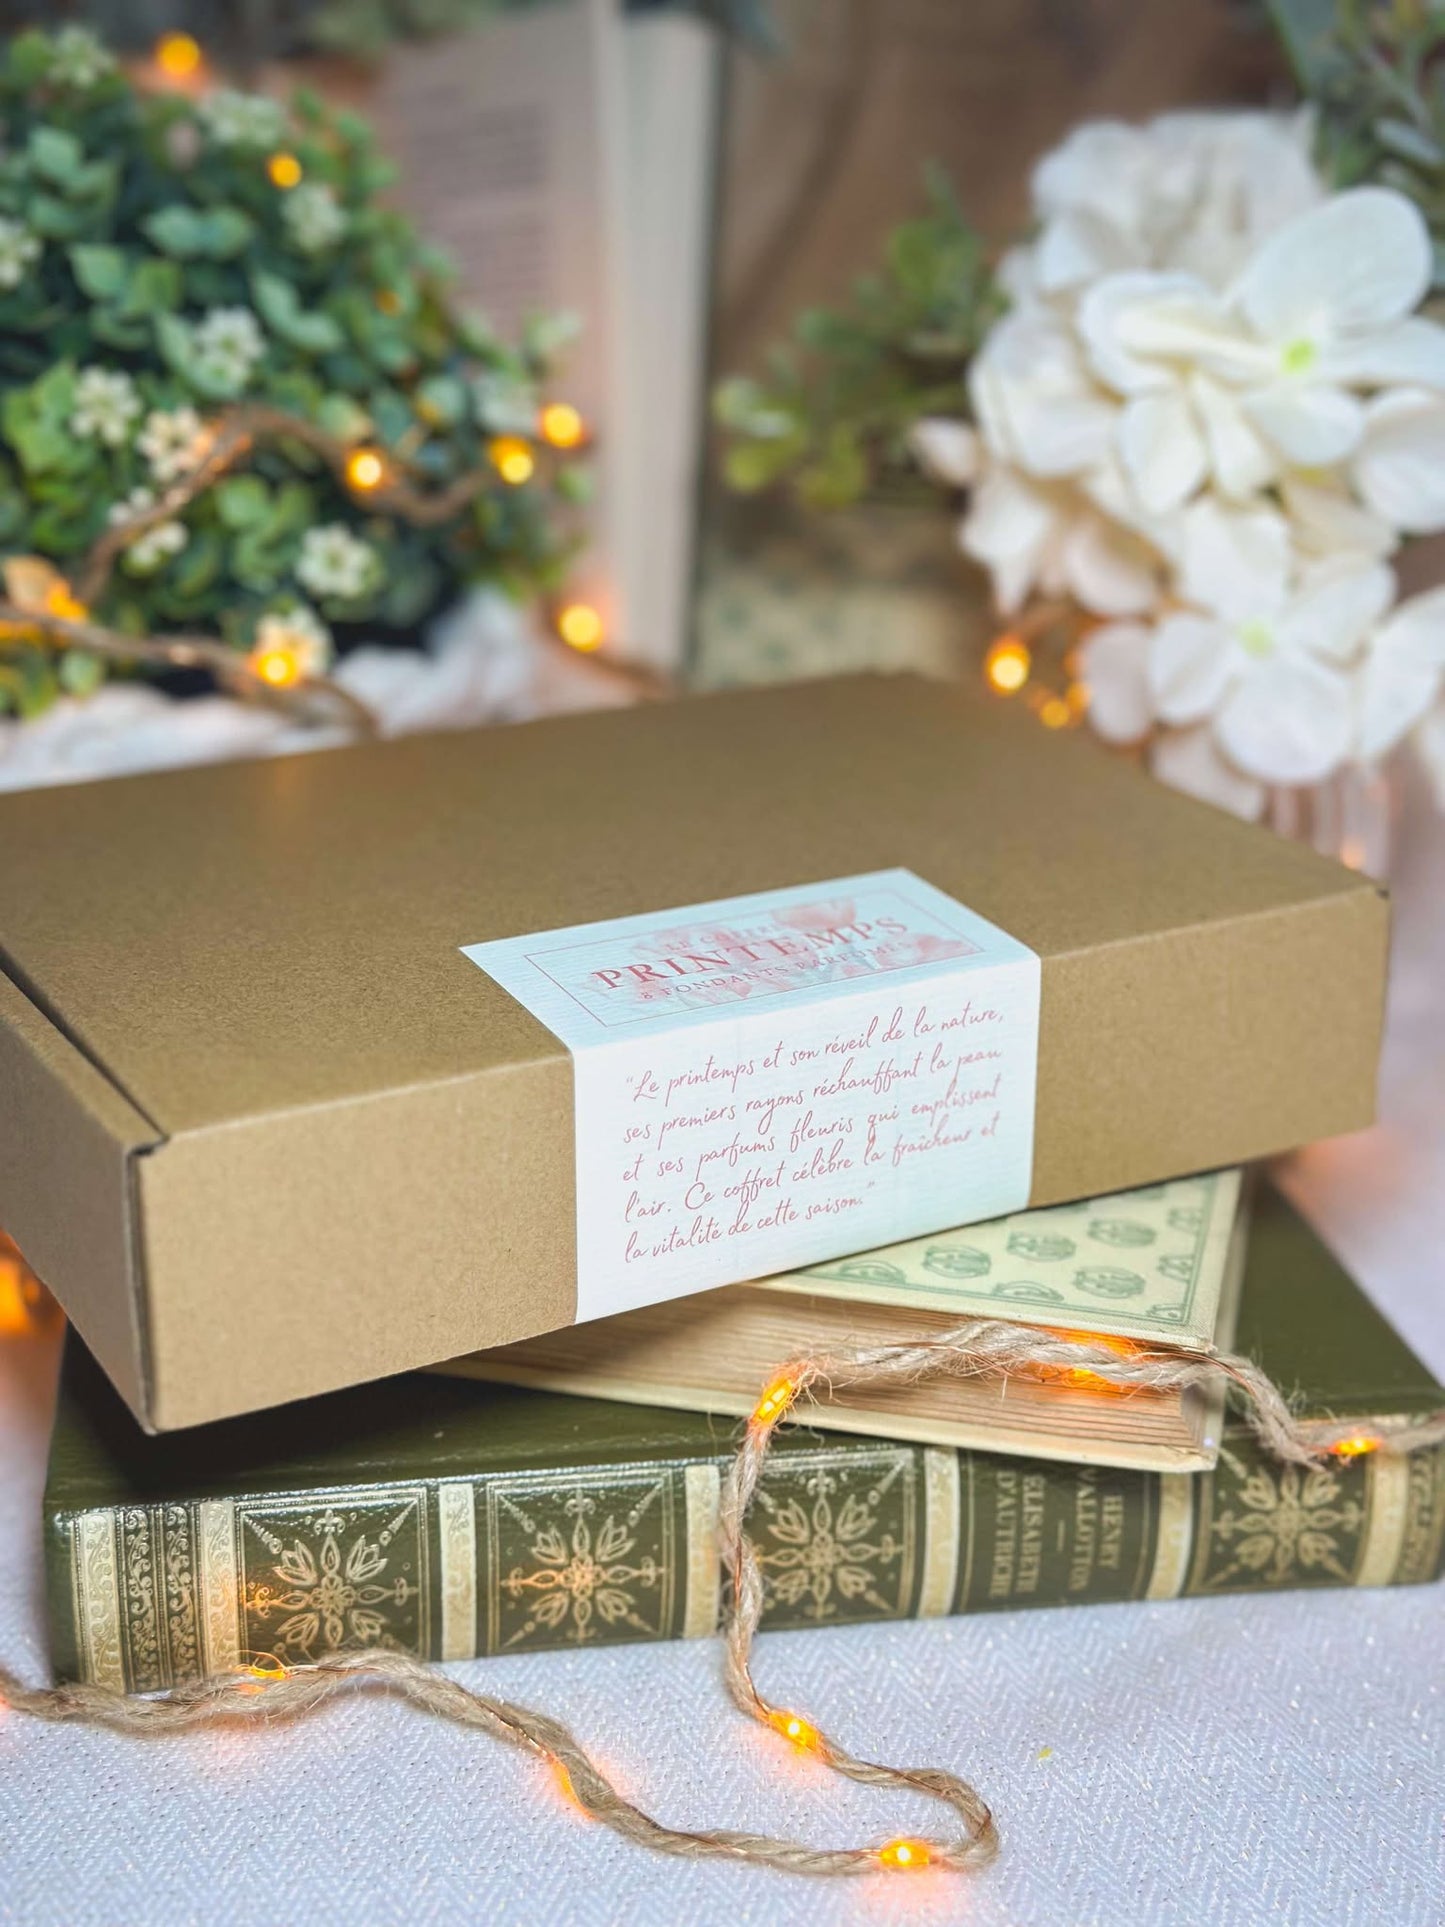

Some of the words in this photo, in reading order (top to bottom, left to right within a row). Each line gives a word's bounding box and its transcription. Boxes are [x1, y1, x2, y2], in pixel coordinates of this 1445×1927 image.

[591, 917, 907, 990] PRINTEMPS
[660, 966, 789, 996] FONDANTS
[623, 1124, 651, 1144] ses
[657, 1104, 737, 1151] premiers
[746, 1089, 804, 1135] rayons
[813, 1051, 923, 1097] réchauffant
[930, 1042, 952, 1073] la
[951, 1050, 1002, 1088] peau
[665, 1055, 754, 1107] printemps
[763, 1040, 784, 1068] et
[790, 1049, 821, 1066] son
[825, 1015, 879, 1055] réveil
[882, 1006, 906, 1043] de
[914, 1006, 936, 1037] la
[941, 1001, 1003, 1031] nature,
[623, 1153, 644, 1181] et
[657, 1157, 684, 1177] ses
[695, 1132, 776, 1182] parfums
[790, 1110, 854, 1153] fleuris
[867, 1105, 900, 1142] qui
[911, 1073, 1002, 1127] emplissent
[624, 1190, 672, 1223] l'air.
[684, 1182, 715, 1210] Ce
[723, 1160, 785, 1202] coffret
[792, 1138, 854, 1182] célèbre
[863, 1138, 886, 1166] la
[892, 1113, 972, 1167] fraîcheur
[980, 1110, 1001, 1137] et
[624, 1231, 648, 1263] la
[652, 1215, 722, 1257] vitalité
[728, 1201, 752, 1236] de
[757, 1197, 799, 1229] cette
[989, 1470, 1017, 1597] D'AUTRICHE
[1068, 1469, 1098, 1591] VALLOTTON
[1098, 1495, 1124, 1569] HENRY
